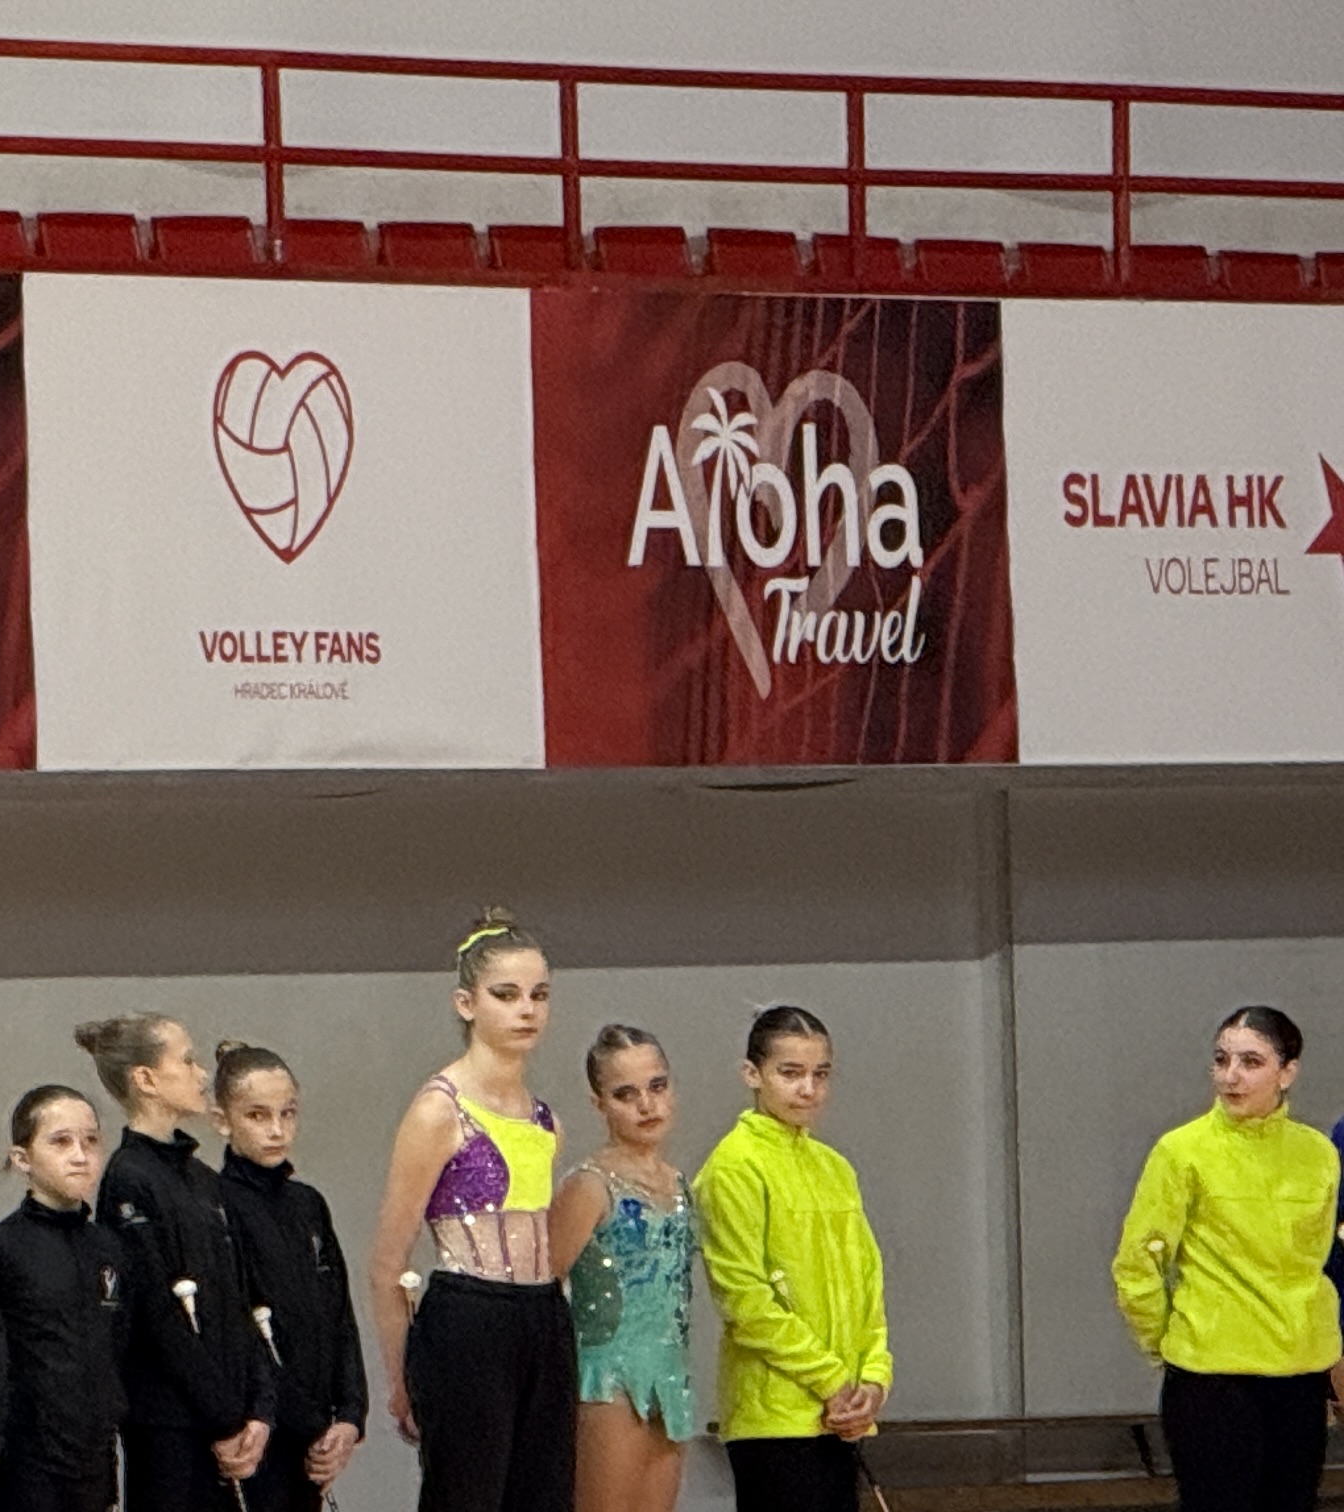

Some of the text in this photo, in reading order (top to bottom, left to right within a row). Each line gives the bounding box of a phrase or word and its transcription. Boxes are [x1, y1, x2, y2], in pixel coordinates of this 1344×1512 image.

[627, 390, 924, 569] Aloha
[1062, 472, 1287, 528] SLAVIA HK
[1145, 557, 1291, 595] VOLEJBAL
[764, 575, 925, 664] Travel
[199, 631, 381, 664] VOLLEY FANS
[234, 681, 287, 699] HRADEC
